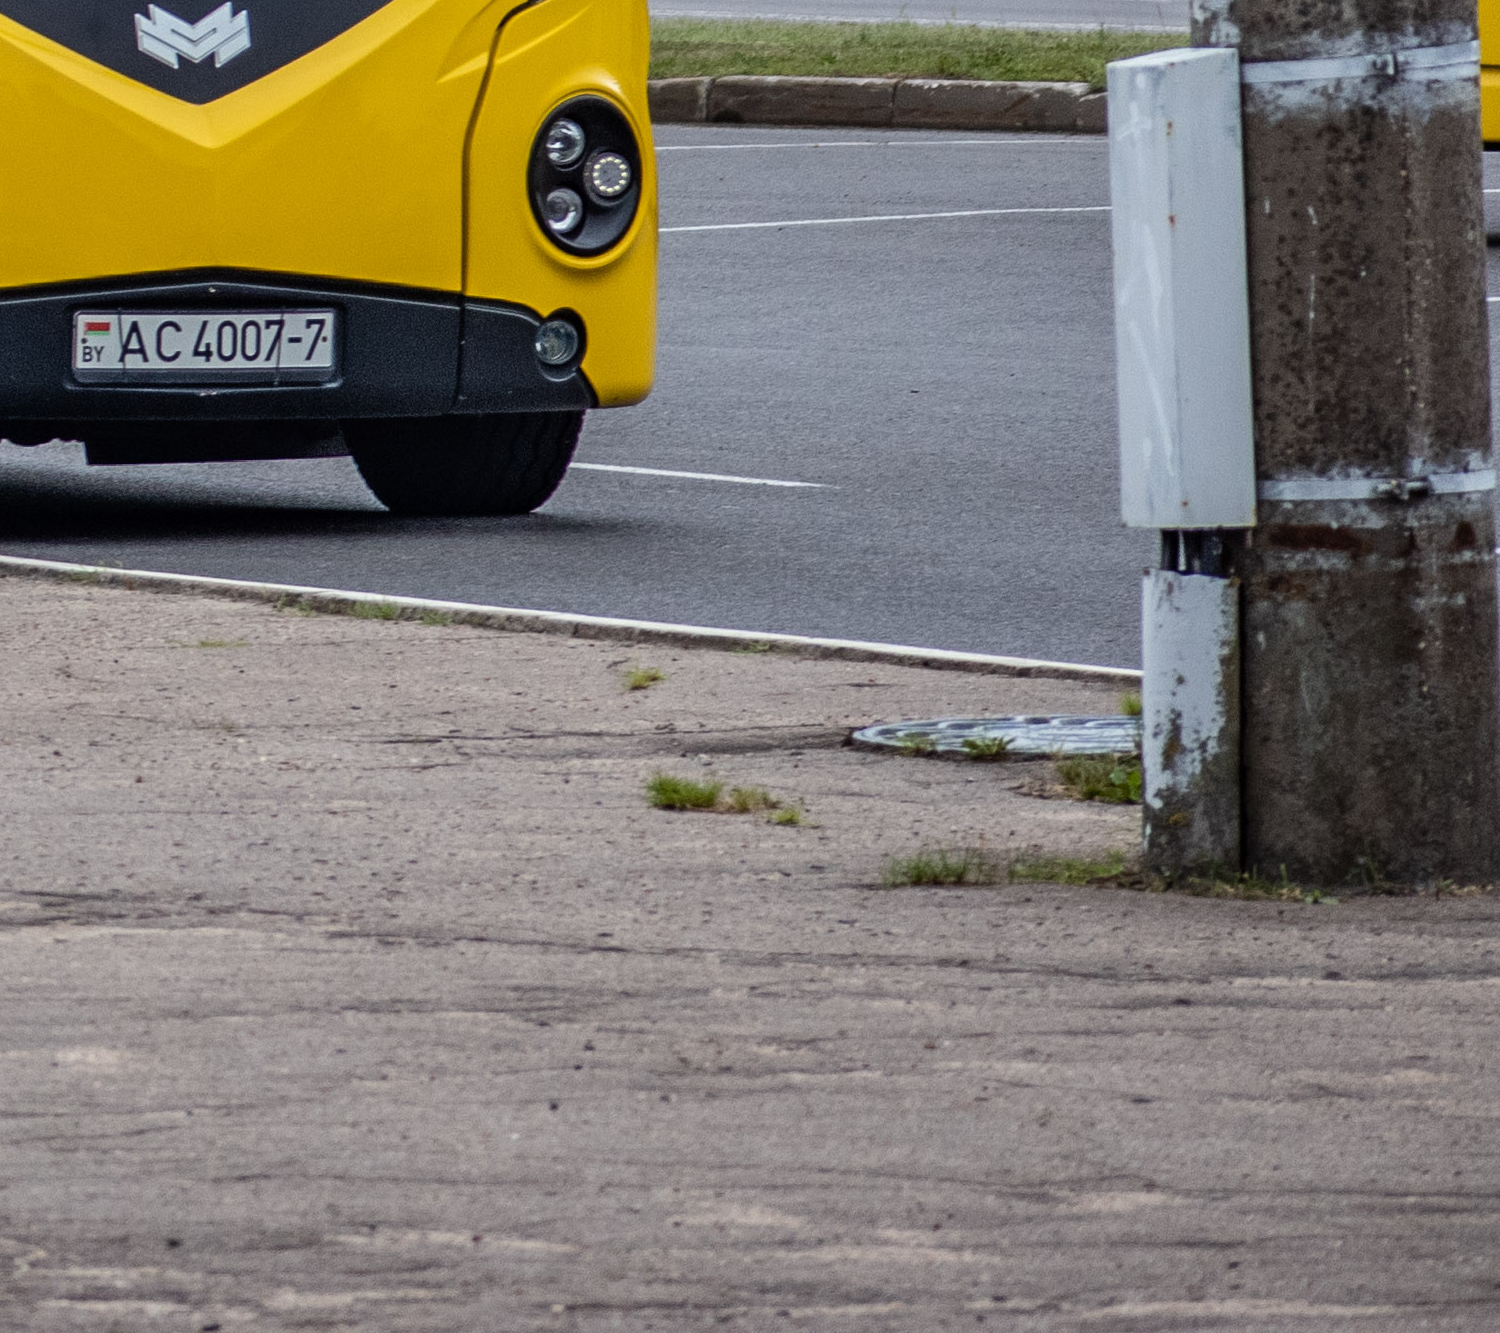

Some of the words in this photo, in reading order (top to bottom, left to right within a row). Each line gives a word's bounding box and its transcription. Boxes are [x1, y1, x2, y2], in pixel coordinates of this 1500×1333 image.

[82, 345, 104, 363] BY
[118, 320, 182, 363] AC
[192, 318, 326, 363] 4007-7
